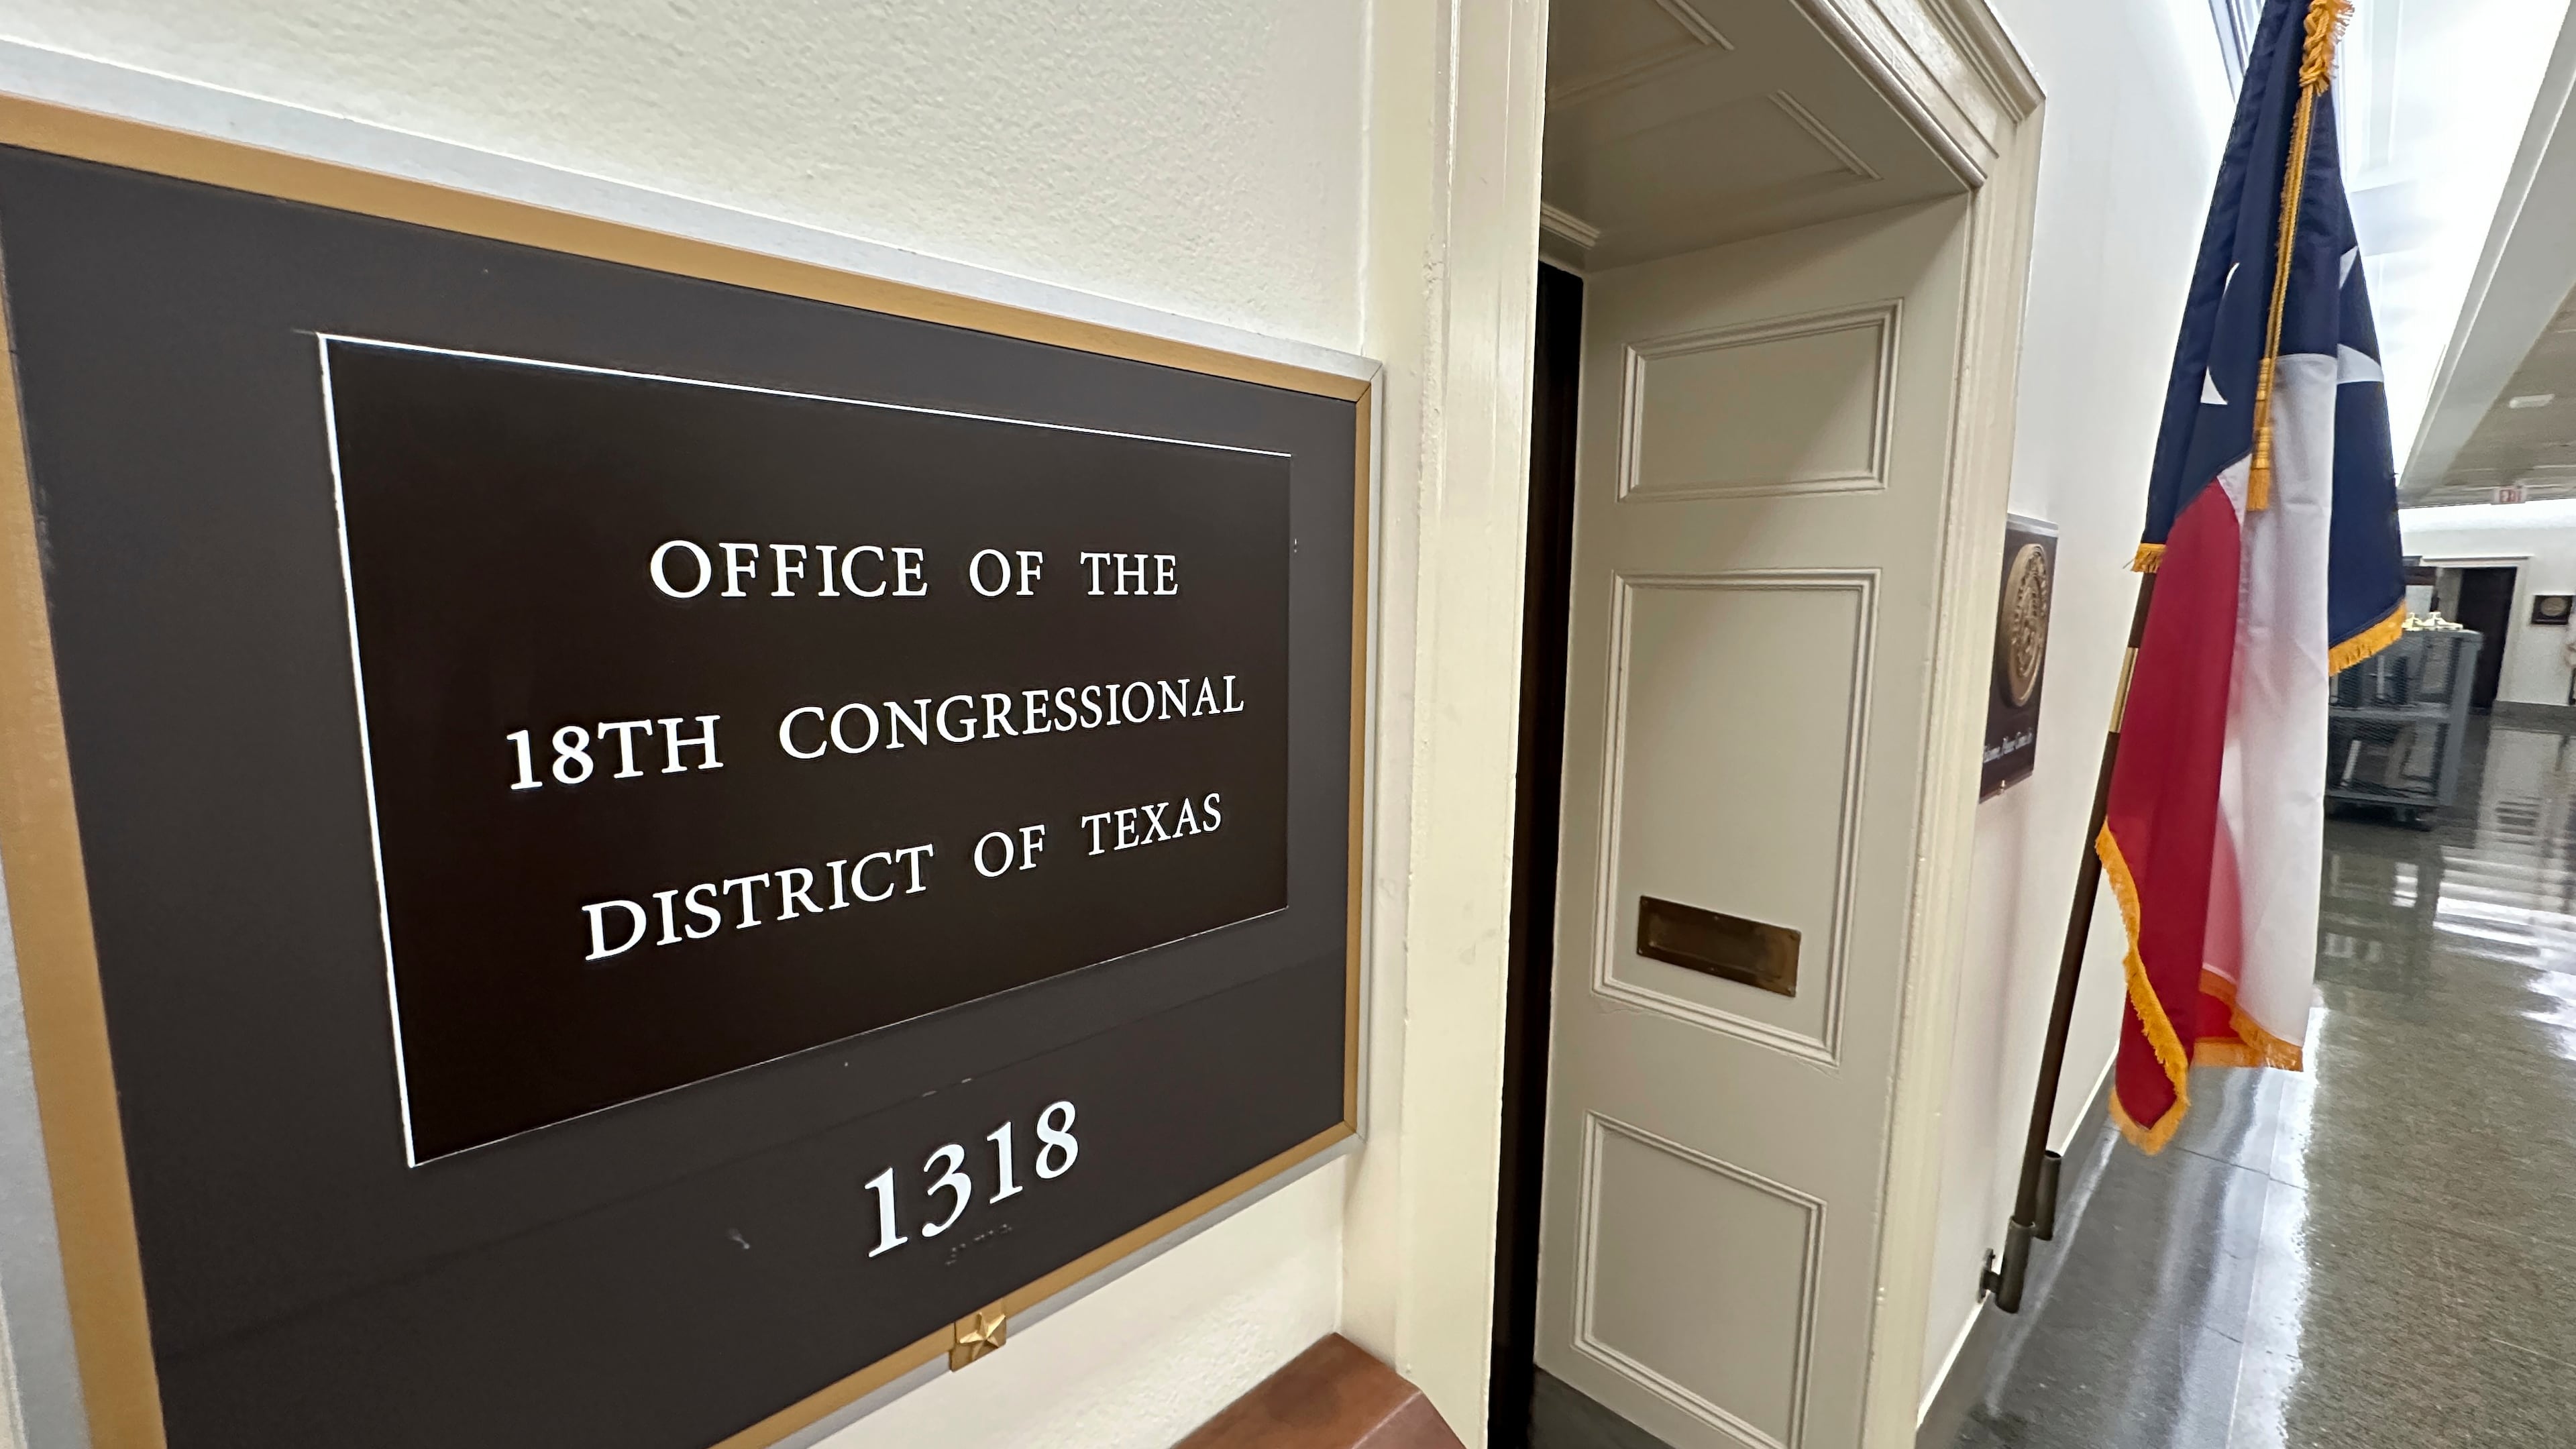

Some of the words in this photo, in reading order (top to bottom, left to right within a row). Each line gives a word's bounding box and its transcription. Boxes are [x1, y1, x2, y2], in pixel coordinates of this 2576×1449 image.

[651, 540, 927, 598] OFFICE
[970, 549, 1042, 596] OF
[1081, 552, 1178, 595] THE
[507, 715, 723, 790] 18TH
[780, 676, 1244, 759] CONGRESSIONAL
[582, 844, 933, 960] DISTRICT
[974, 824, 1044, 877] OF
[1081, 794, 1220, 855] TEXAS
[865, 1102, 1078, 1257] 1318
